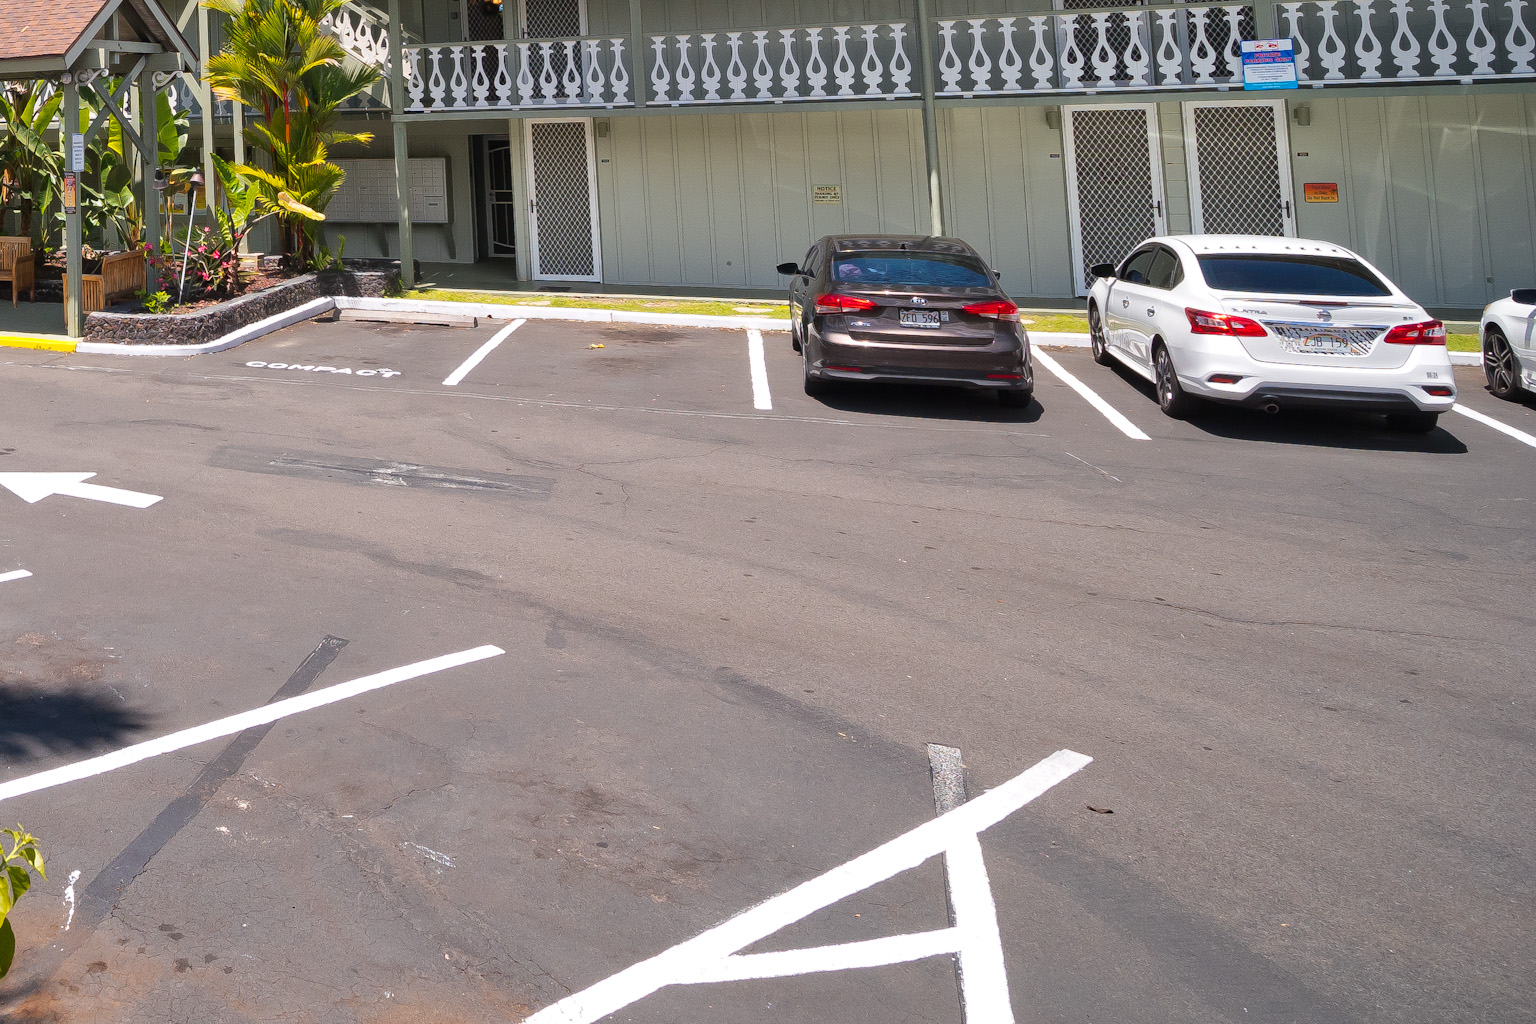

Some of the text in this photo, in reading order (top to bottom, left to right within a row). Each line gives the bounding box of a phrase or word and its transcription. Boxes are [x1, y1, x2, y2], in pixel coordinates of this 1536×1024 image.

[923, 314, 939, 323] 596
[1304, 336, 1348, 348] ZJB 159
[245, 361, 402, 378] COMPACT
